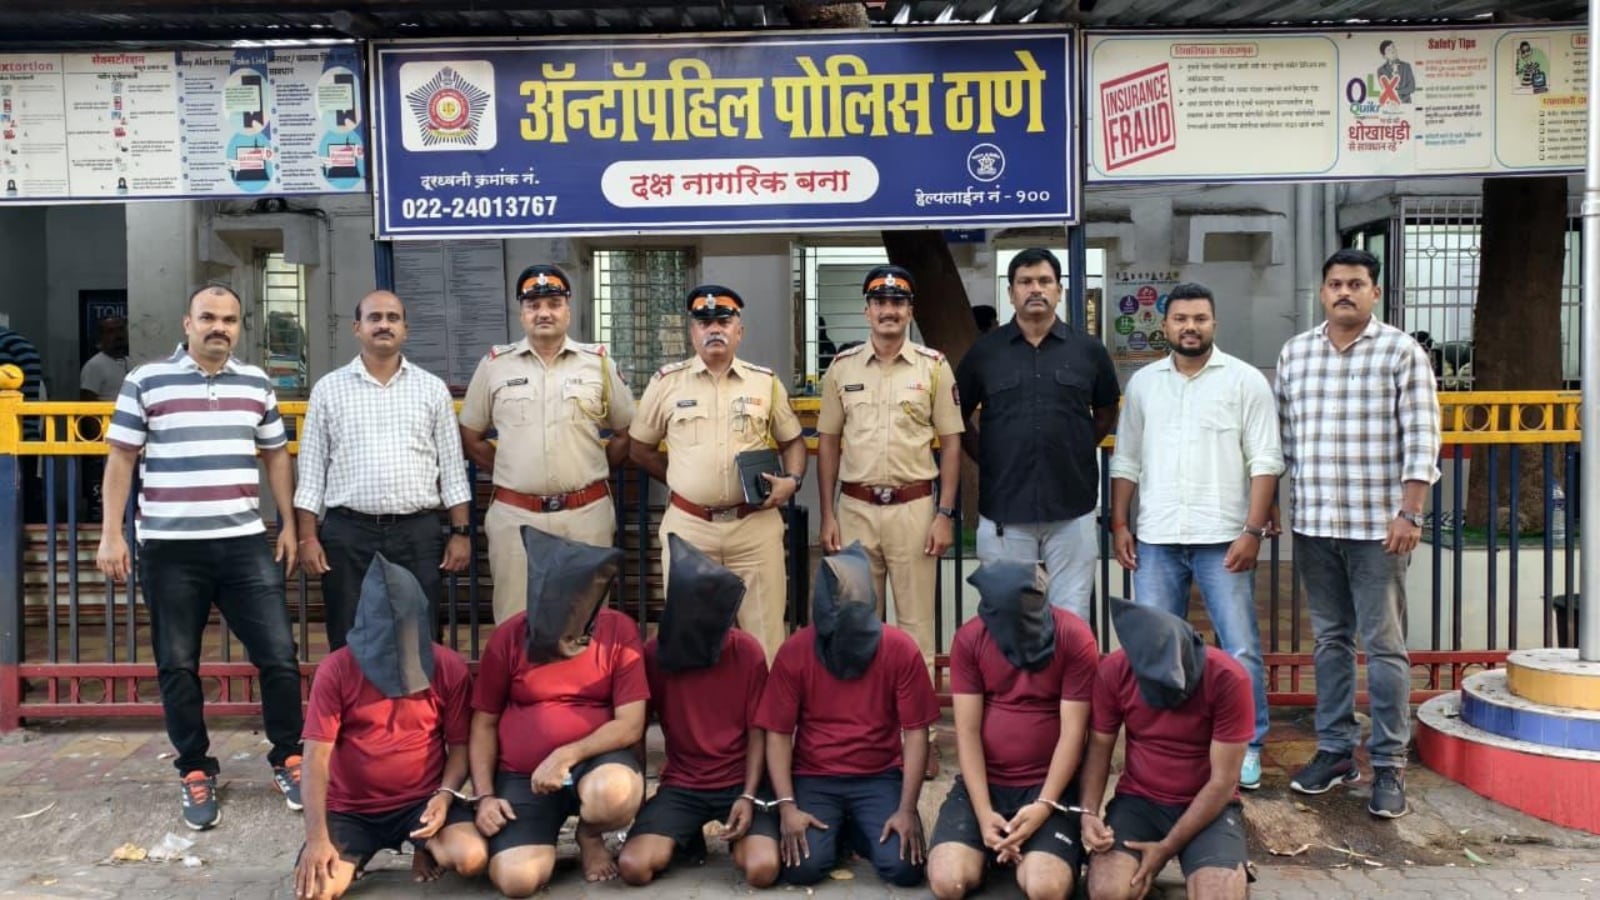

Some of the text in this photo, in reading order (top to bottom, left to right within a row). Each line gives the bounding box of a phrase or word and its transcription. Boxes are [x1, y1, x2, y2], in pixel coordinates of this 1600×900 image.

[1428, 37, 1477, 51] Safety Tips
[194, 55, 212, 66] Alert
[213, 54, 231, 66] from
[771, 54, 935, 138] पोलिस
[942, 50, 1047, 134] ठाणे
[1106, 74, 1169, 117] INSURANCE
[1346, 74, 1401, 105] OLX
[1350, 101, 1380, 115] Quikr
[1108, 102, 1170, 160] FRAUD
[420, 167, 540, 191] दूरध्वनी क्रमांक नं.
[630, 165, 850, 200] दक्ष नागरिक बना
[402, 195, 558, 219] 022-24013767
[915, 186, 985, 206] हेल्पलाईन
[987, 184, 1000, 203] नं
